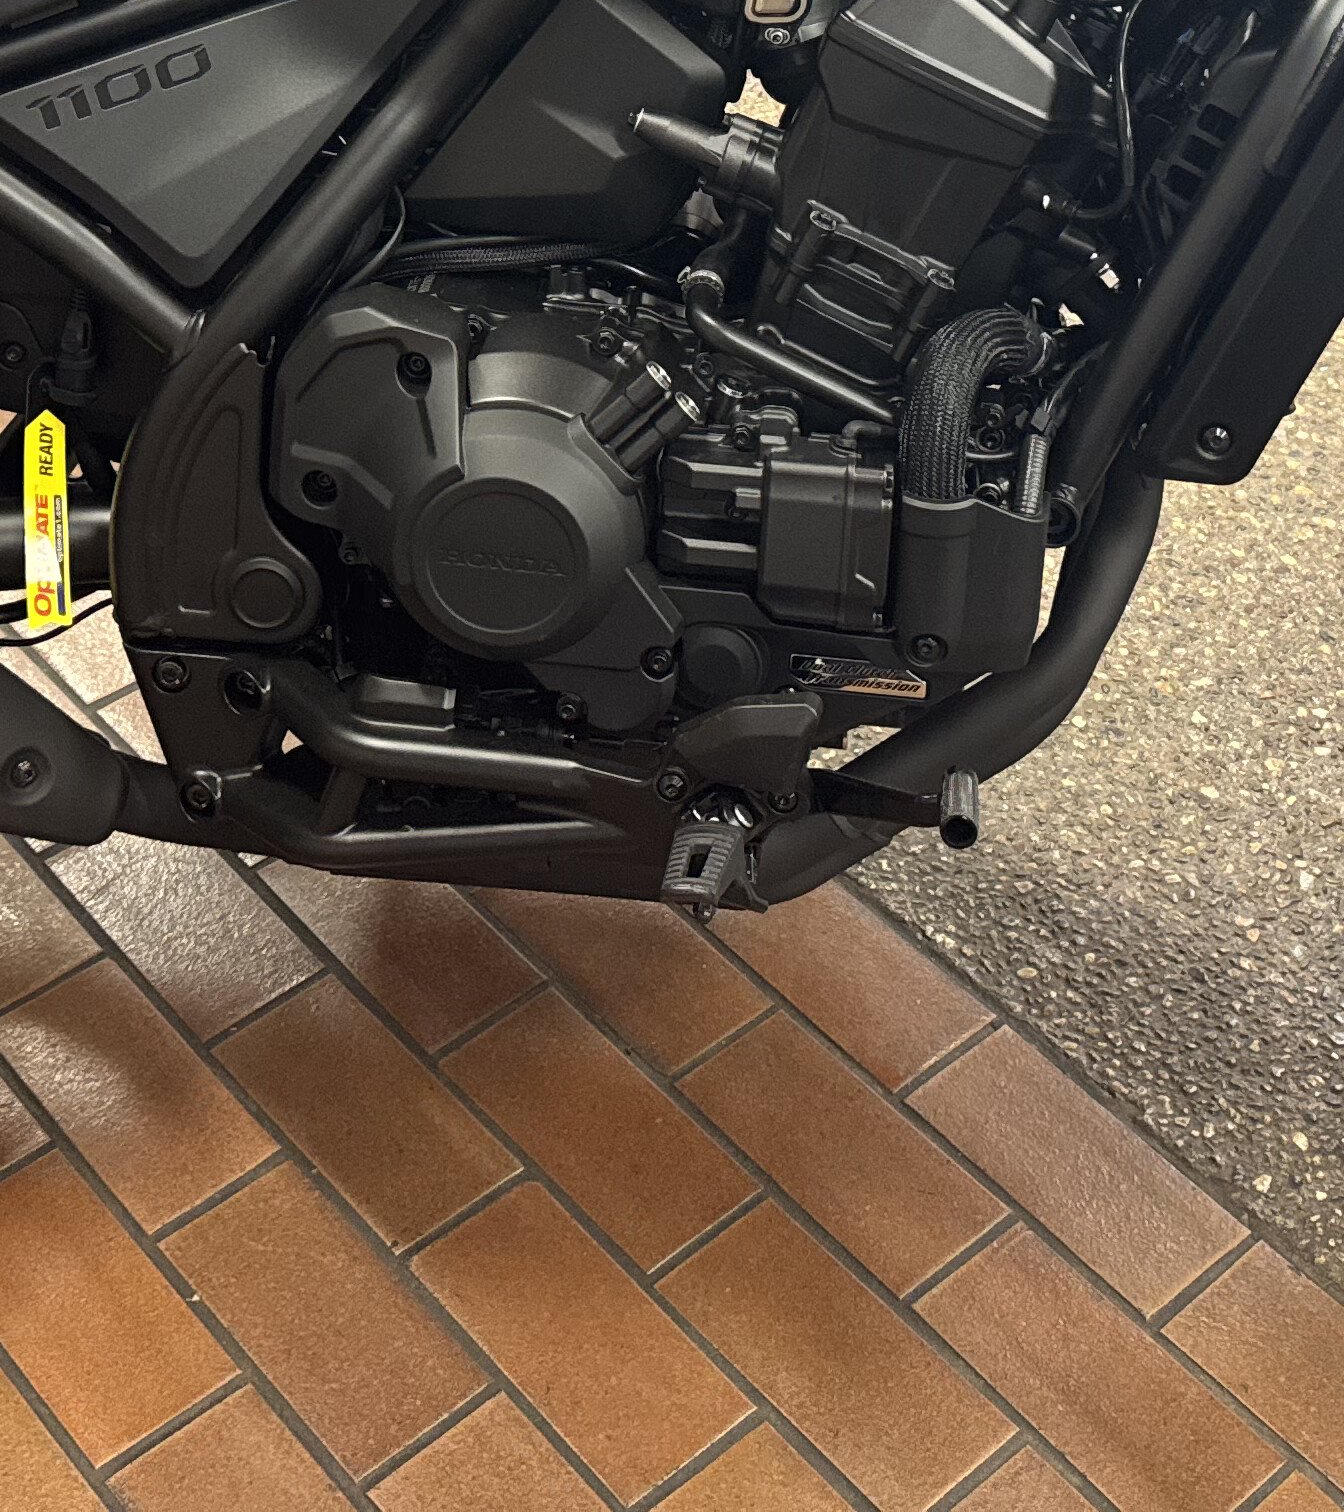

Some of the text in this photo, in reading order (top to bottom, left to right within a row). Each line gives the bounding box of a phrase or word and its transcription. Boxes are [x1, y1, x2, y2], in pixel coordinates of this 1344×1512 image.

[25, 43, 212, 130] 1100
[39, 422, 54, 477] READY
[435, 546, 567, 580] HONDA
